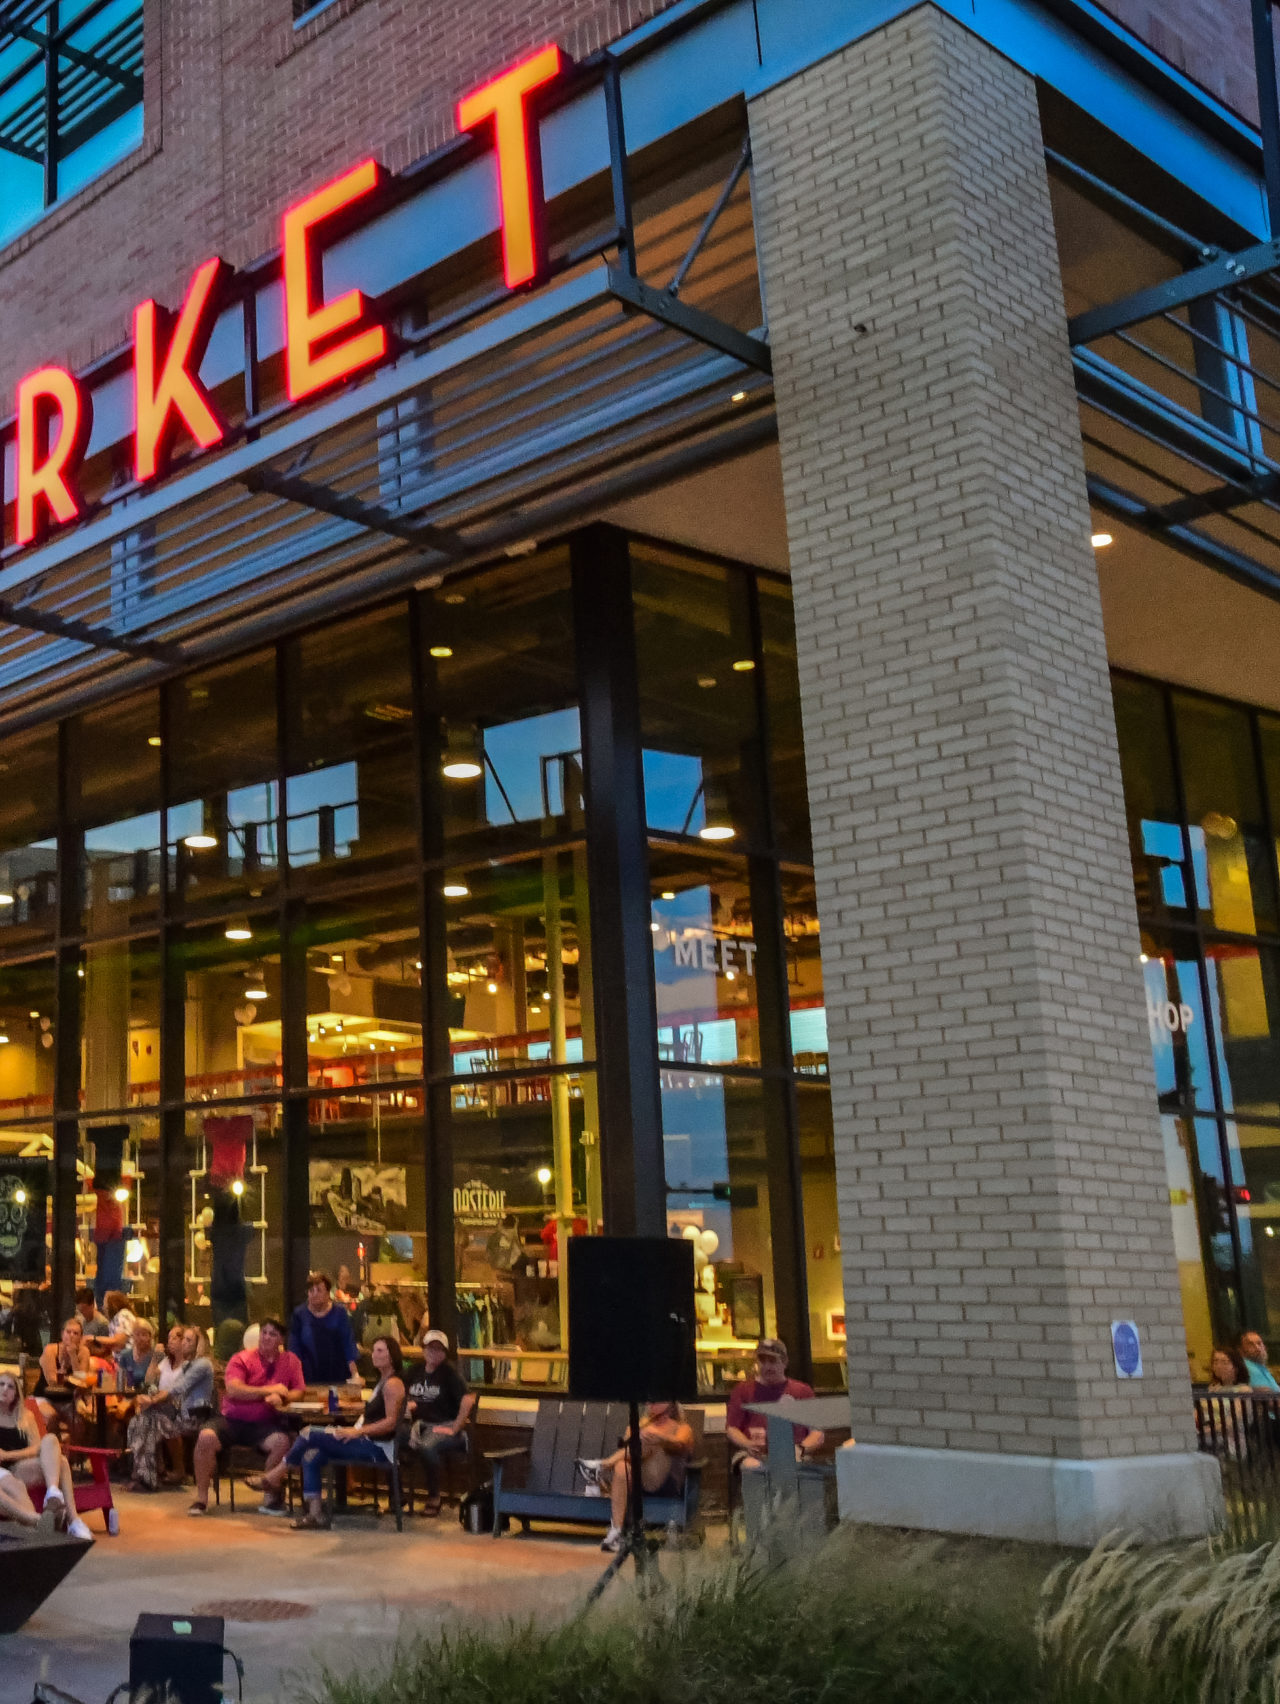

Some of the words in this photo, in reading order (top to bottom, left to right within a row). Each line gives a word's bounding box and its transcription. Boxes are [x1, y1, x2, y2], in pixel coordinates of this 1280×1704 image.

[675, 936, 757, 977] MEET
[1147, 998, 1194, 1032] HOP
[453, 1187, 507, 1219] OASTERIE
